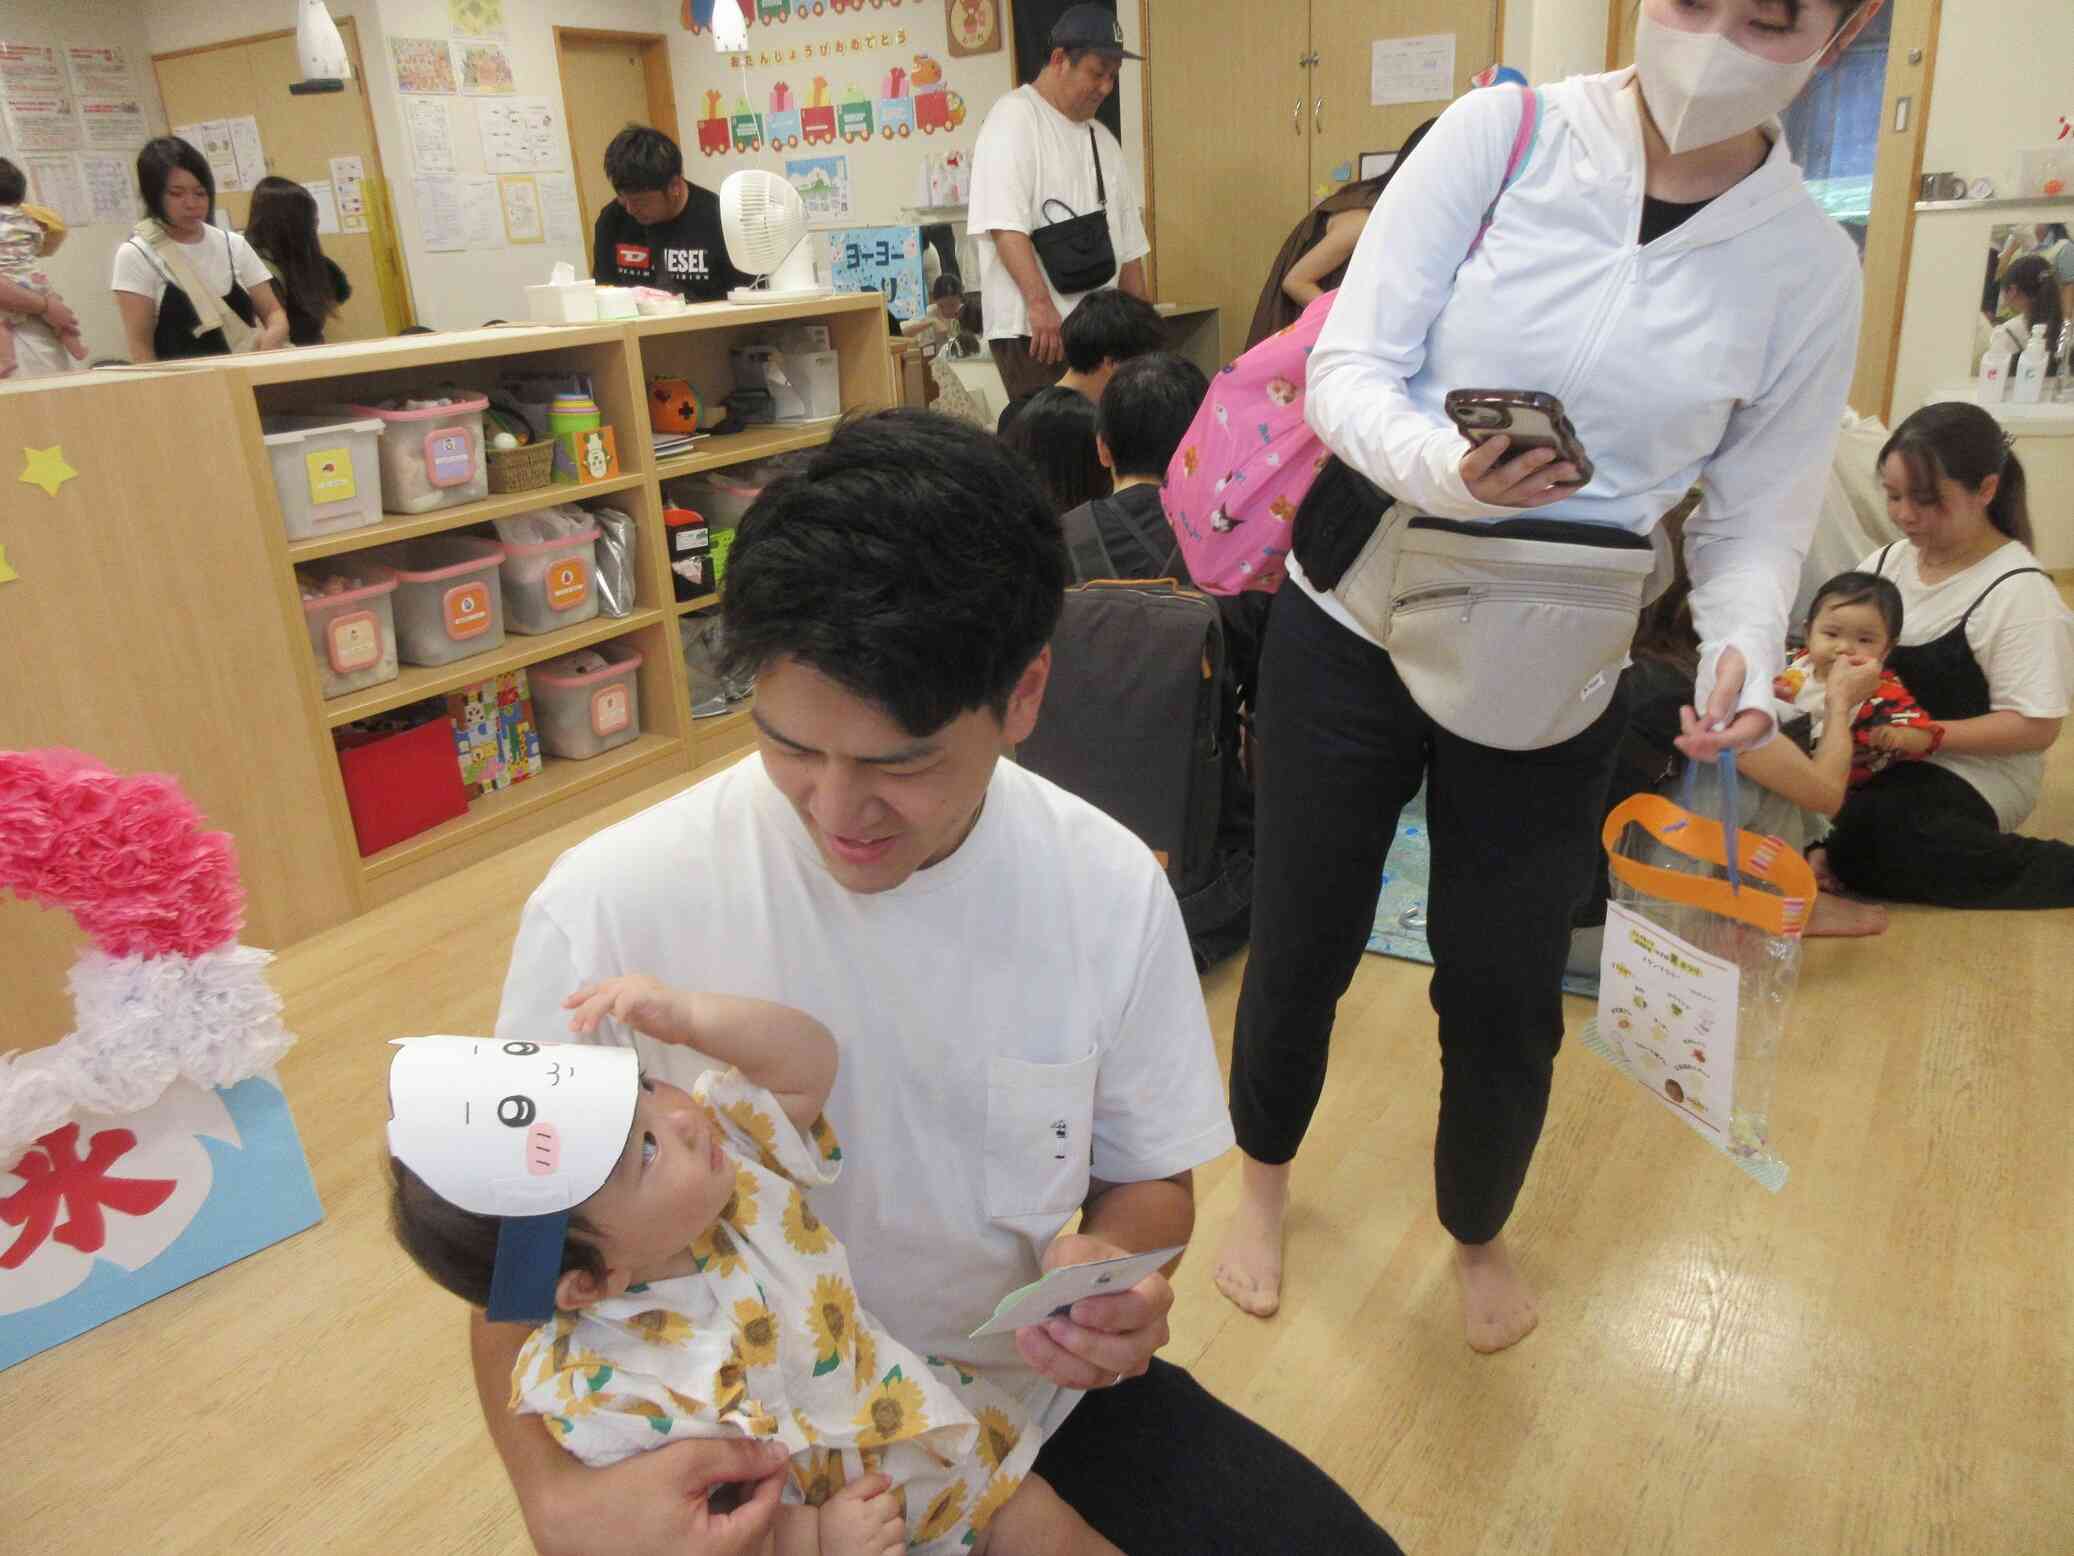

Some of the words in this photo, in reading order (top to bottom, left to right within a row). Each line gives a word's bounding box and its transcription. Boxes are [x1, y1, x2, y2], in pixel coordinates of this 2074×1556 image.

[730, 28, 908, 69] おたんじょうびおめでとう
[846, 240, 905, 269] ヨーヨー
[0, 1121, 178, 1270] 氷
